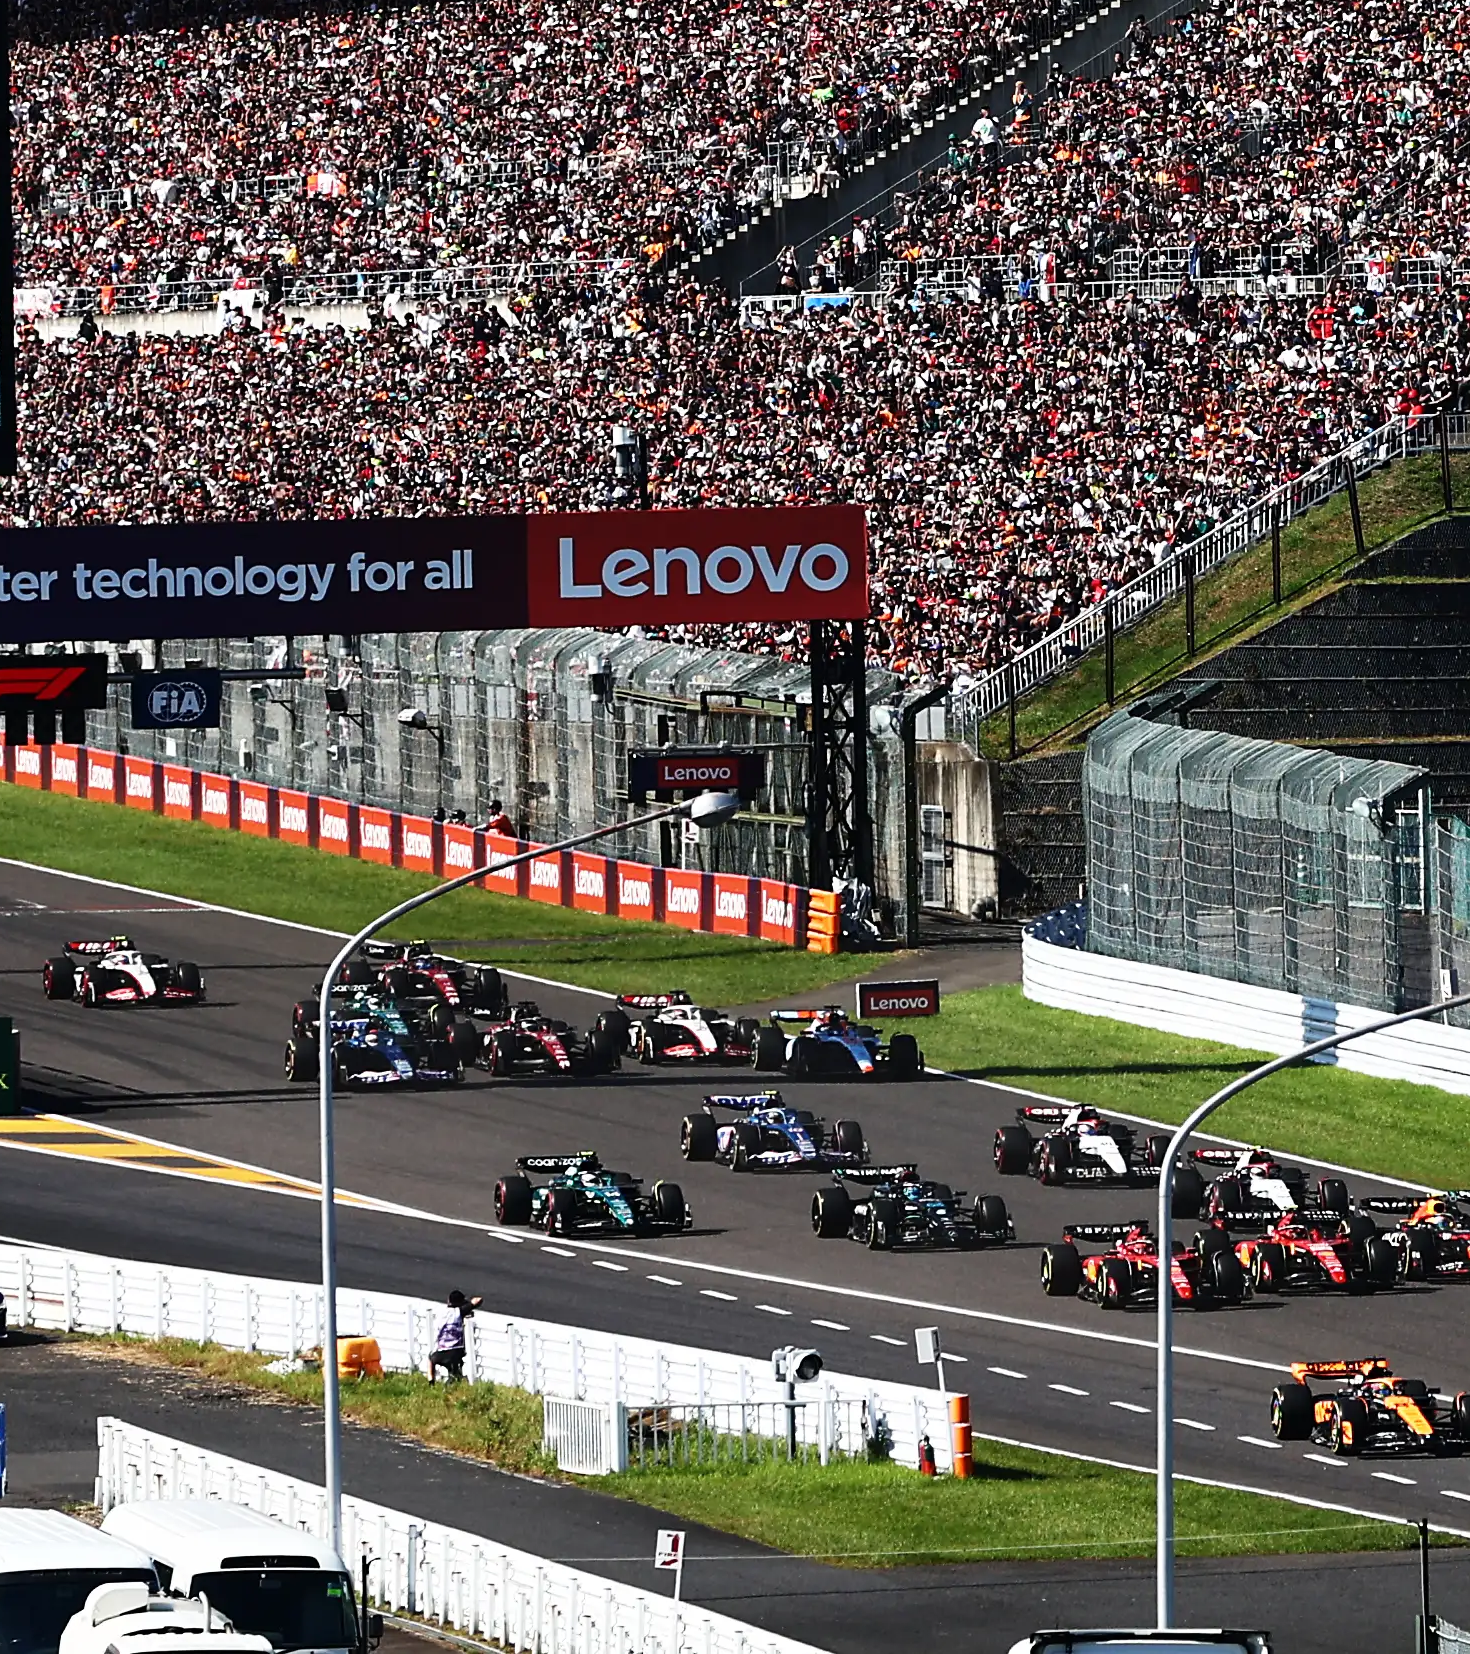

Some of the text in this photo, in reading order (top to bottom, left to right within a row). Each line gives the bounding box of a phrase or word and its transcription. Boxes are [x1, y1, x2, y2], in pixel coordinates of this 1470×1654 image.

[74, 556, 335, 602] technology
[347, 551, 416, 592] for
[424, 550, 473, 591] all
[559, 537, 849, 598] Lenovo
[126, 766, 151, 798] Lenovo
[664, 765, 730, 781] Lenovo
[164, 774, 189, 807] Lenovo
[202, 782, 227, 815] Lenovo
[241, 791, 266, 824] Lenovo
[280, 800, 307, 832] Lenovo
[319, 808, 348, 842] Lenovo
[360, 817, 389, 850] Lenovo
[403, 825, 431, 859] Lenovo
[445, 834, 472, 869] Lenovo
[530, 859, 559, 888] Lenovo
[574, 863, 604, 898] Lenovo
[619, 873, 650, 907] Lenovo
[668, 880, 699, 914] Lenovo
[715, 885, 746, 920] Lenovo
[762, 890, 793, 927] Lenoo
[870, 996, 928, 1011] Lenovo
